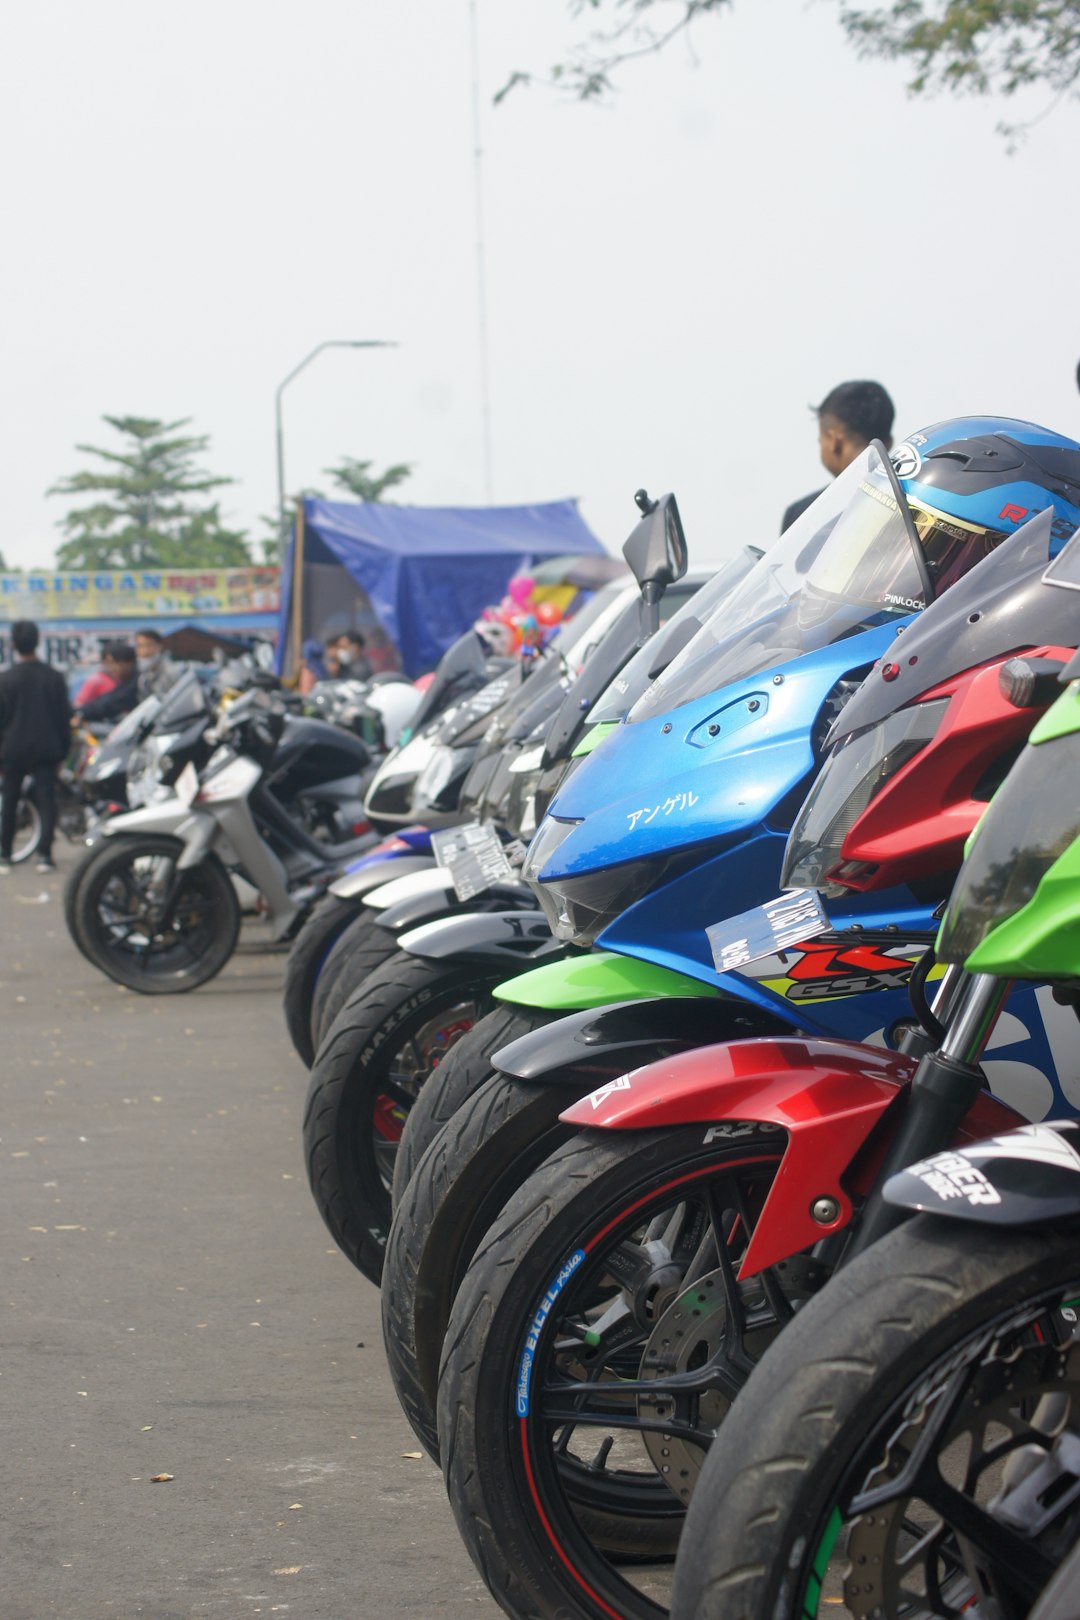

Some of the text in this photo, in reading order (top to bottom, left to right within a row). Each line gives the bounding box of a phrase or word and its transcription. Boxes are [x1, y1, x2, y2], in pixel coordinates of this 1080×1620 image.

[884, 593, 925, 610] PINLOCK
[626, 791, 699, 831] アンゲル
[785, 970, 913, 998] GSX
[361, 989, 431, 1067] MAXXIS
[517, 1253, 582, 1413] Takasago EXCEL Asia
